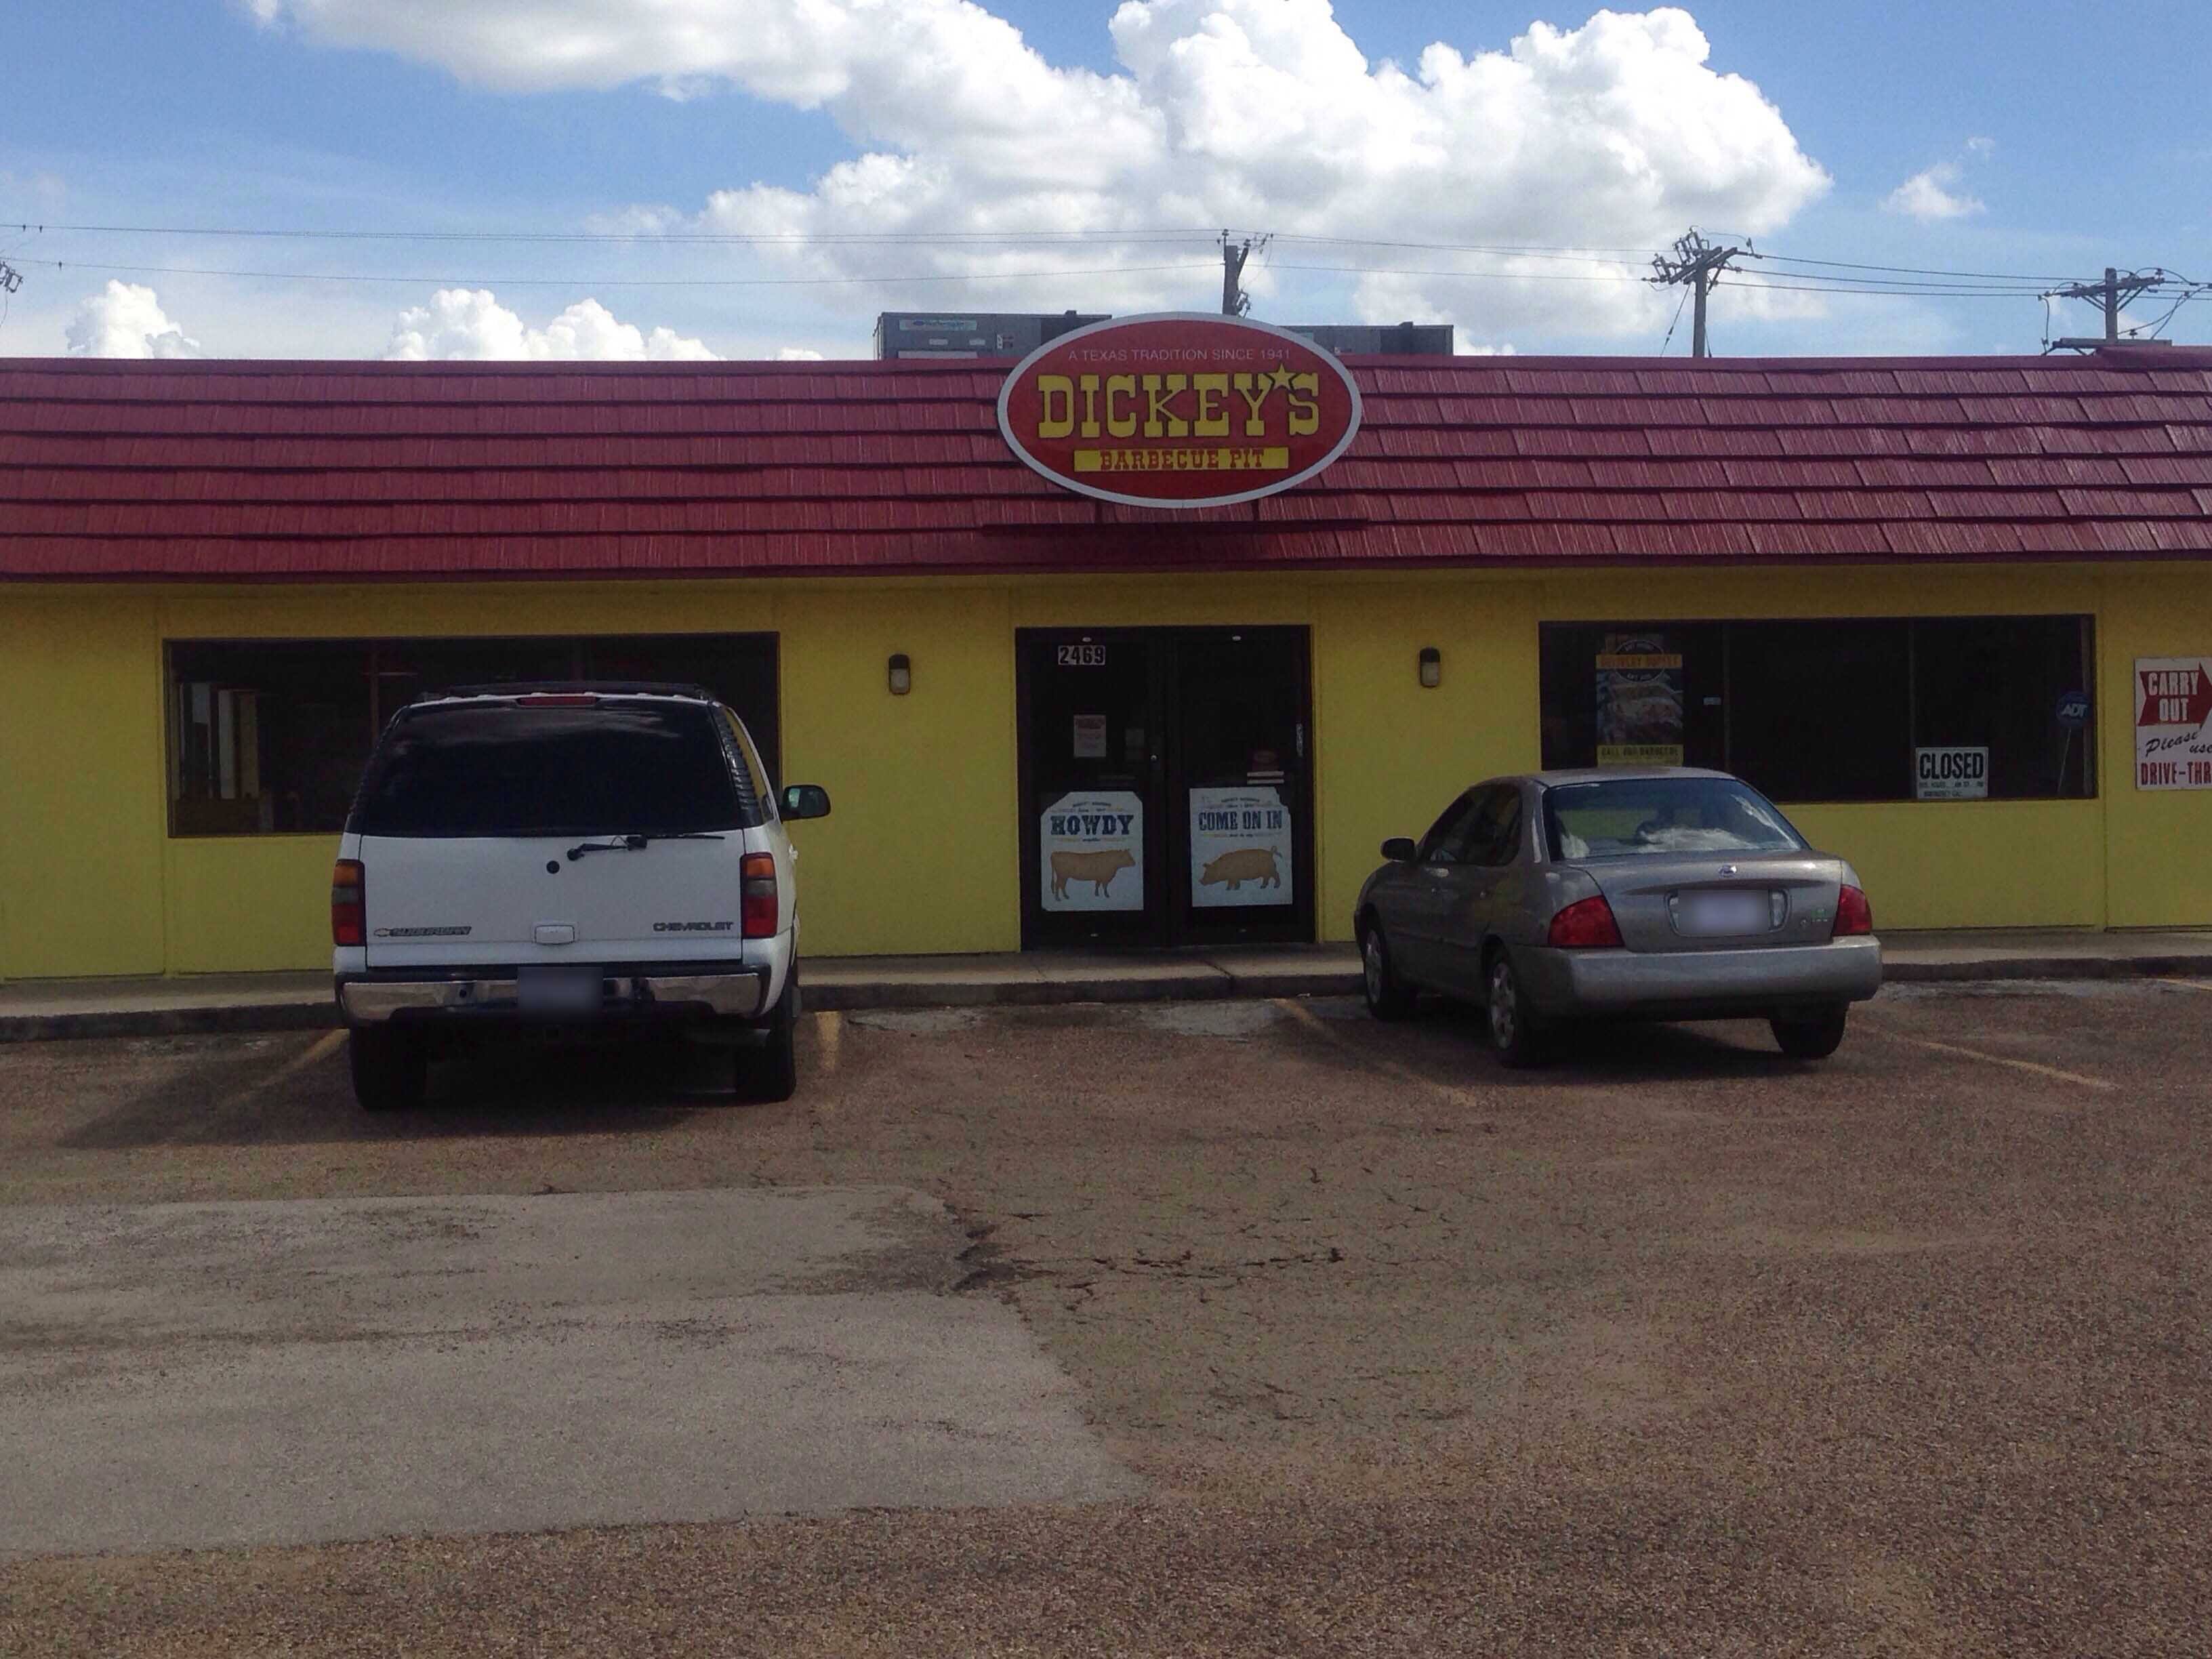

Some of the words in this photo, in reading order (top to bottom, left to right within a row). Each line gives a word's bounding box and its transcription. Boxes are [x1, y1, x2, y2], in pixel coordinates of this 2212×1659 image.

[1068, 350, 1078, 361] A
[1082, 349, 1127, 361] TEXAS
[1131, 348, 1208, 361] TRADITION
[1212, 348, 1254, 361] SINCE
[1260, 348, 1290, 360] 1941
[1100, 449, 1219, 470] BARBECUE
[1229, 449, 1265, 468] PIT
[1060, 646, 1105, 664] 2469
[2147, 671, 2200, 697] CARRY
[2061, 703, 2089, 718] ADT
[2158, 697, 2190, 722] OUT
[2145, 731, 2198, 758] Please
[1919, 752, 1984, 779] CLOSED
[1050, 815, 1134, 836] HOWDY
[1198, 811, 1238, 831] COME
[1242, 811, 1261, 830] ON
[1266, 810, 1283, 830] IN
[653, 921, 734, 932] CHEVROLET
